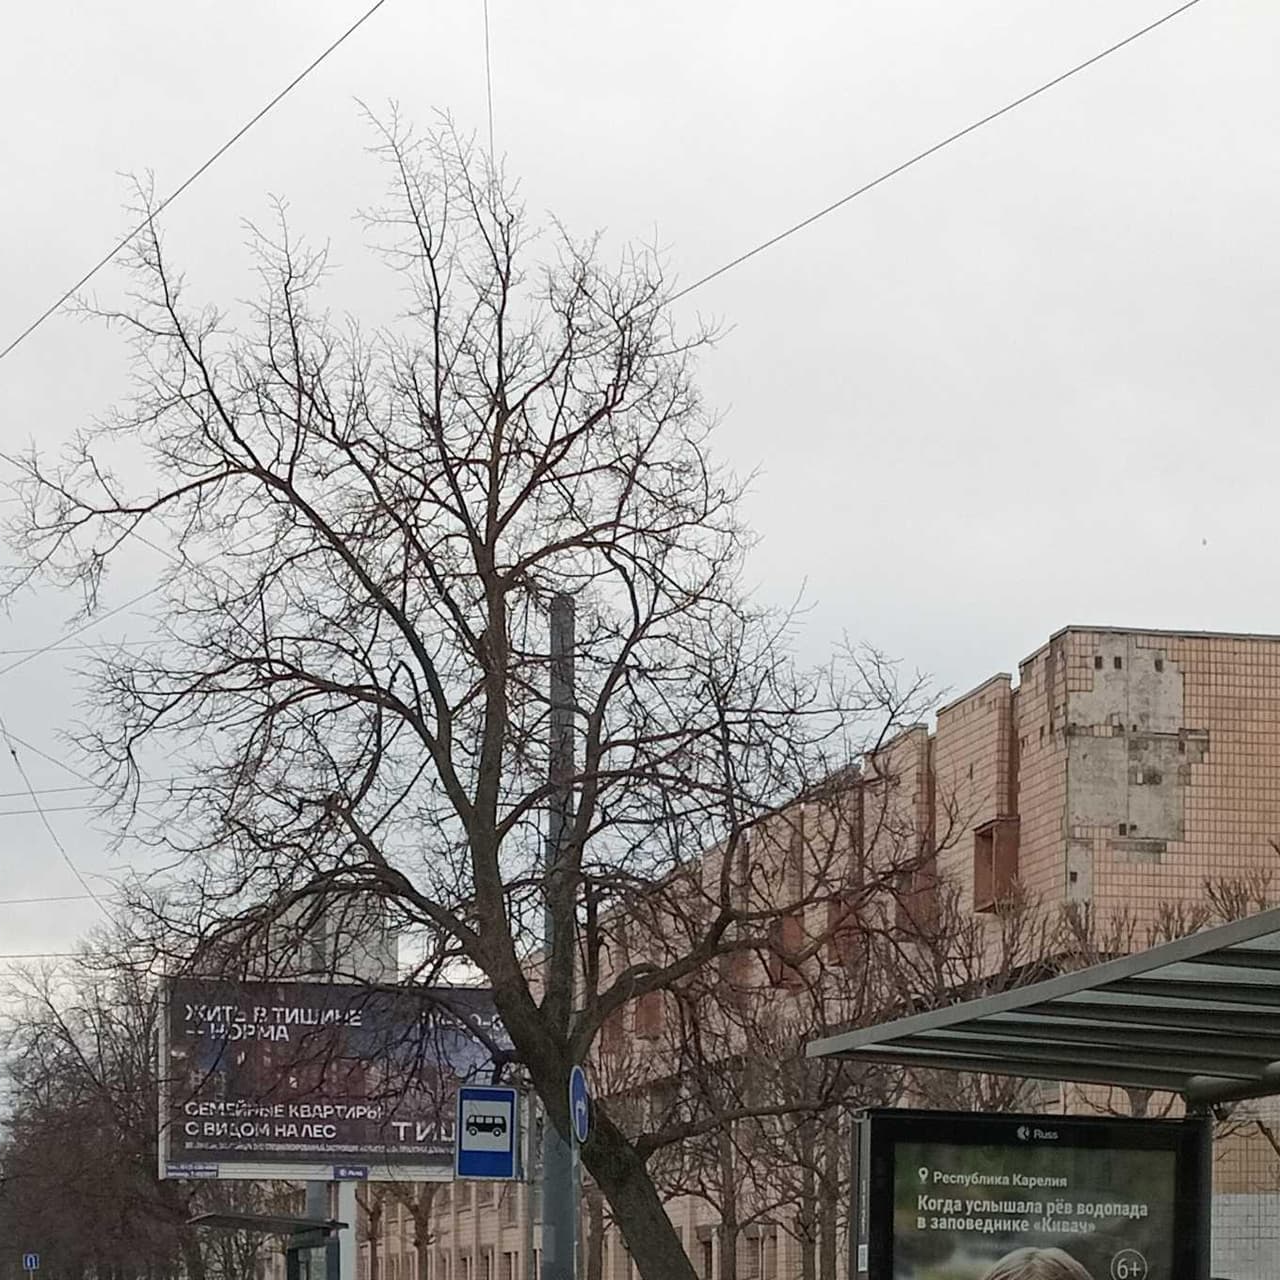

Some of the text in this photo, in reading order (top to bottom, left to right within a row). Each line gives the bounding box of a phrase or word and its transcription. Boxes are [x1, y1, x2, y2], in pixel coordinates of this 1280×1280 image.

[288, 1104, 383, 1120] КВАРТИРЫ
[184, 1121, 337, 1138] С ВИДОМ НА ЛЕС
[1033, 1128, 1059, 1140] Russ
[933, 1171, 1068, 1188] Республика Карелия
[917, 1195, 1149, 1219] Когда услышала рёв водопада
[917, 1217, 1096, 1234] в заповеднике «Кивач»
[1117, 1258, 1141, 1279] 6+
